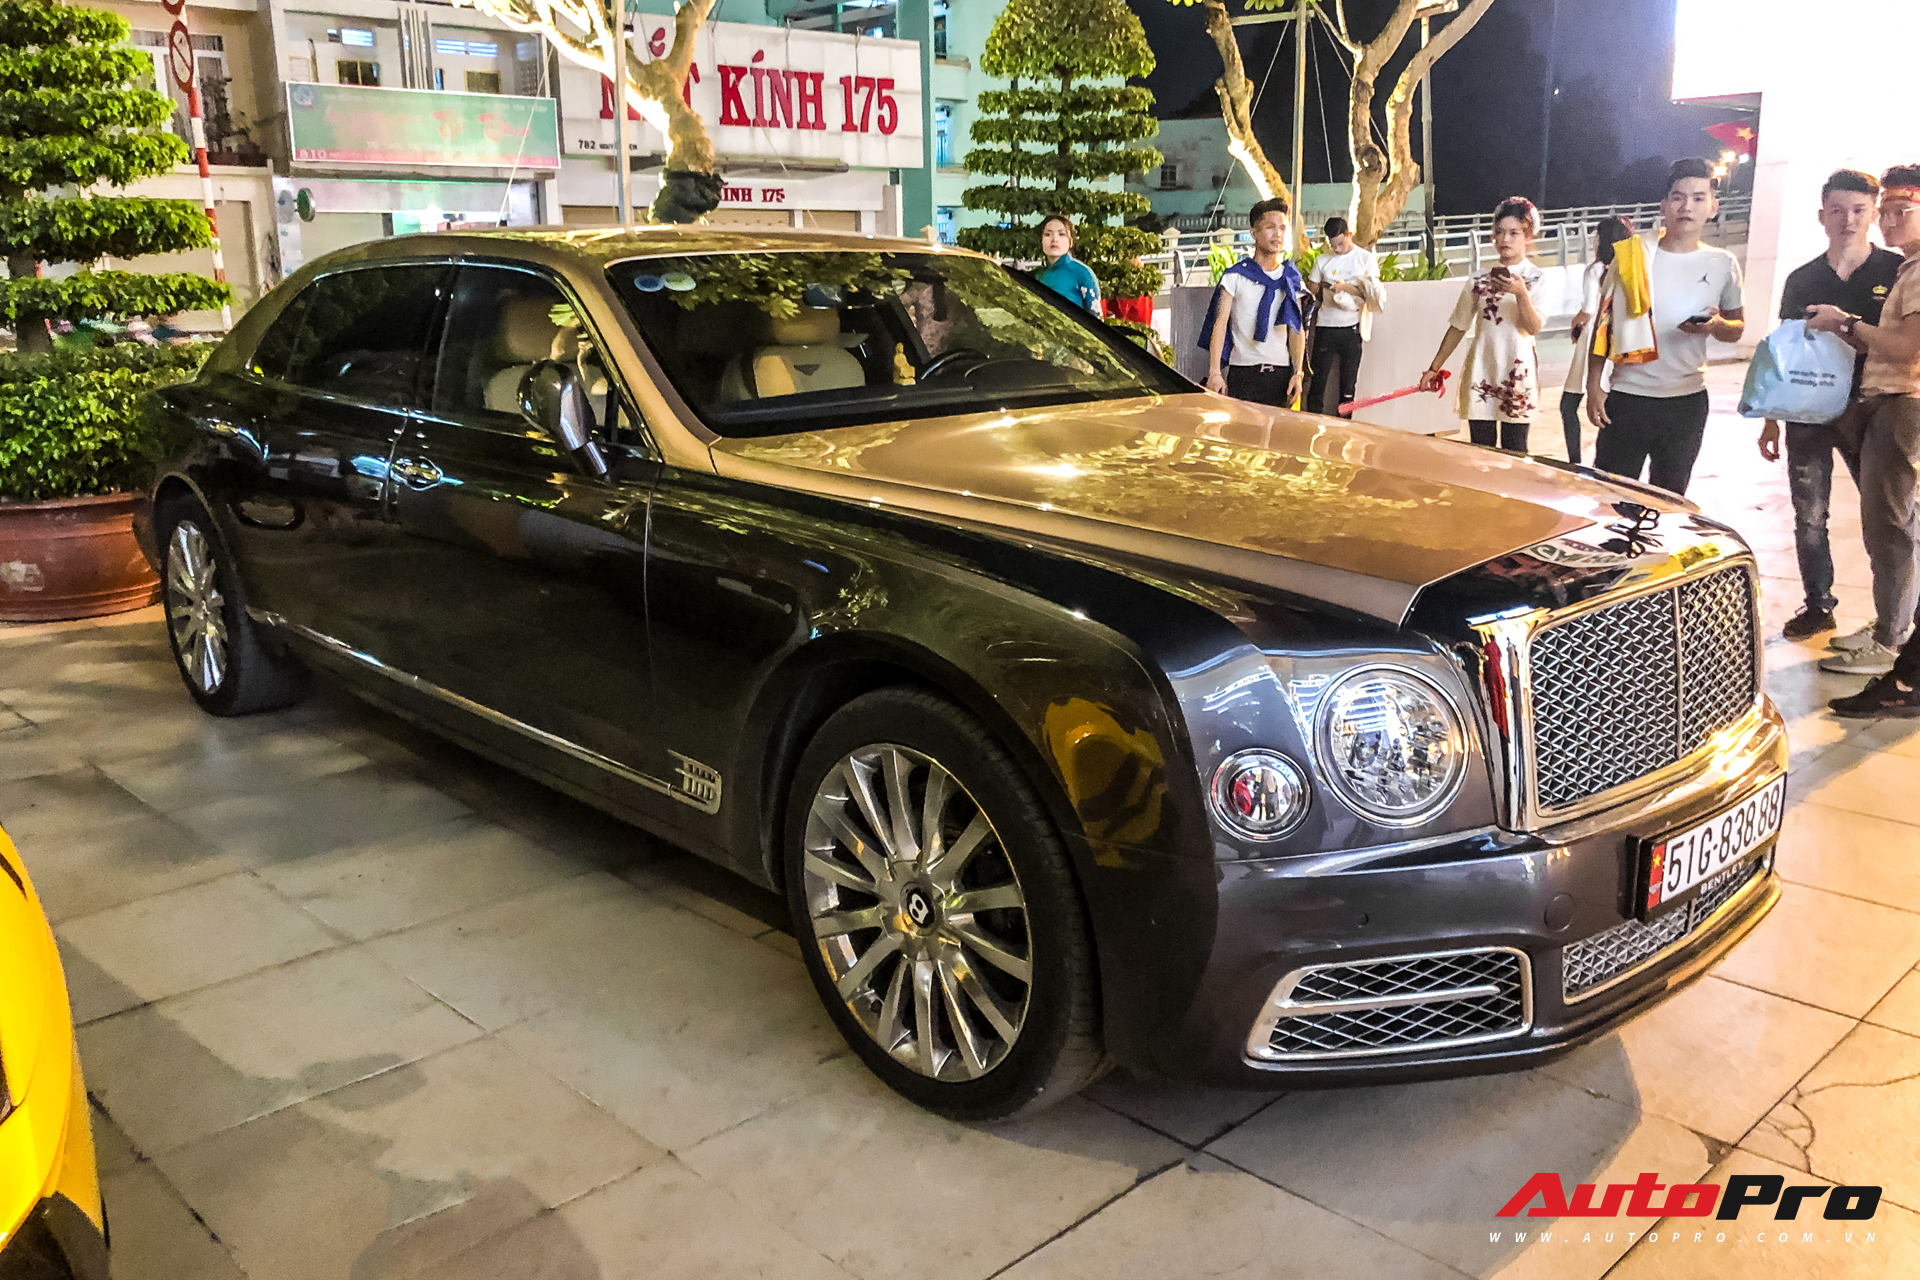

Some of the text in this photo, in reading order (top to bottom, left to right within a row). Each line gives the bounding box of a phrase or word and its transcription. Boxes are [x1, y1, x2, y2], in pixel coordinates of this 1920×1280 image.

[717, 49, 827, 130] KÍNH
[839, 75, 899, 135] 175
[578, 139, 596, 149] 782
[720, 182, 786, 203] ÍNH 175
[1667, 783, 1780, 892] 51G-838.88
[1700, 862, 1744, 893] BENTLEY
